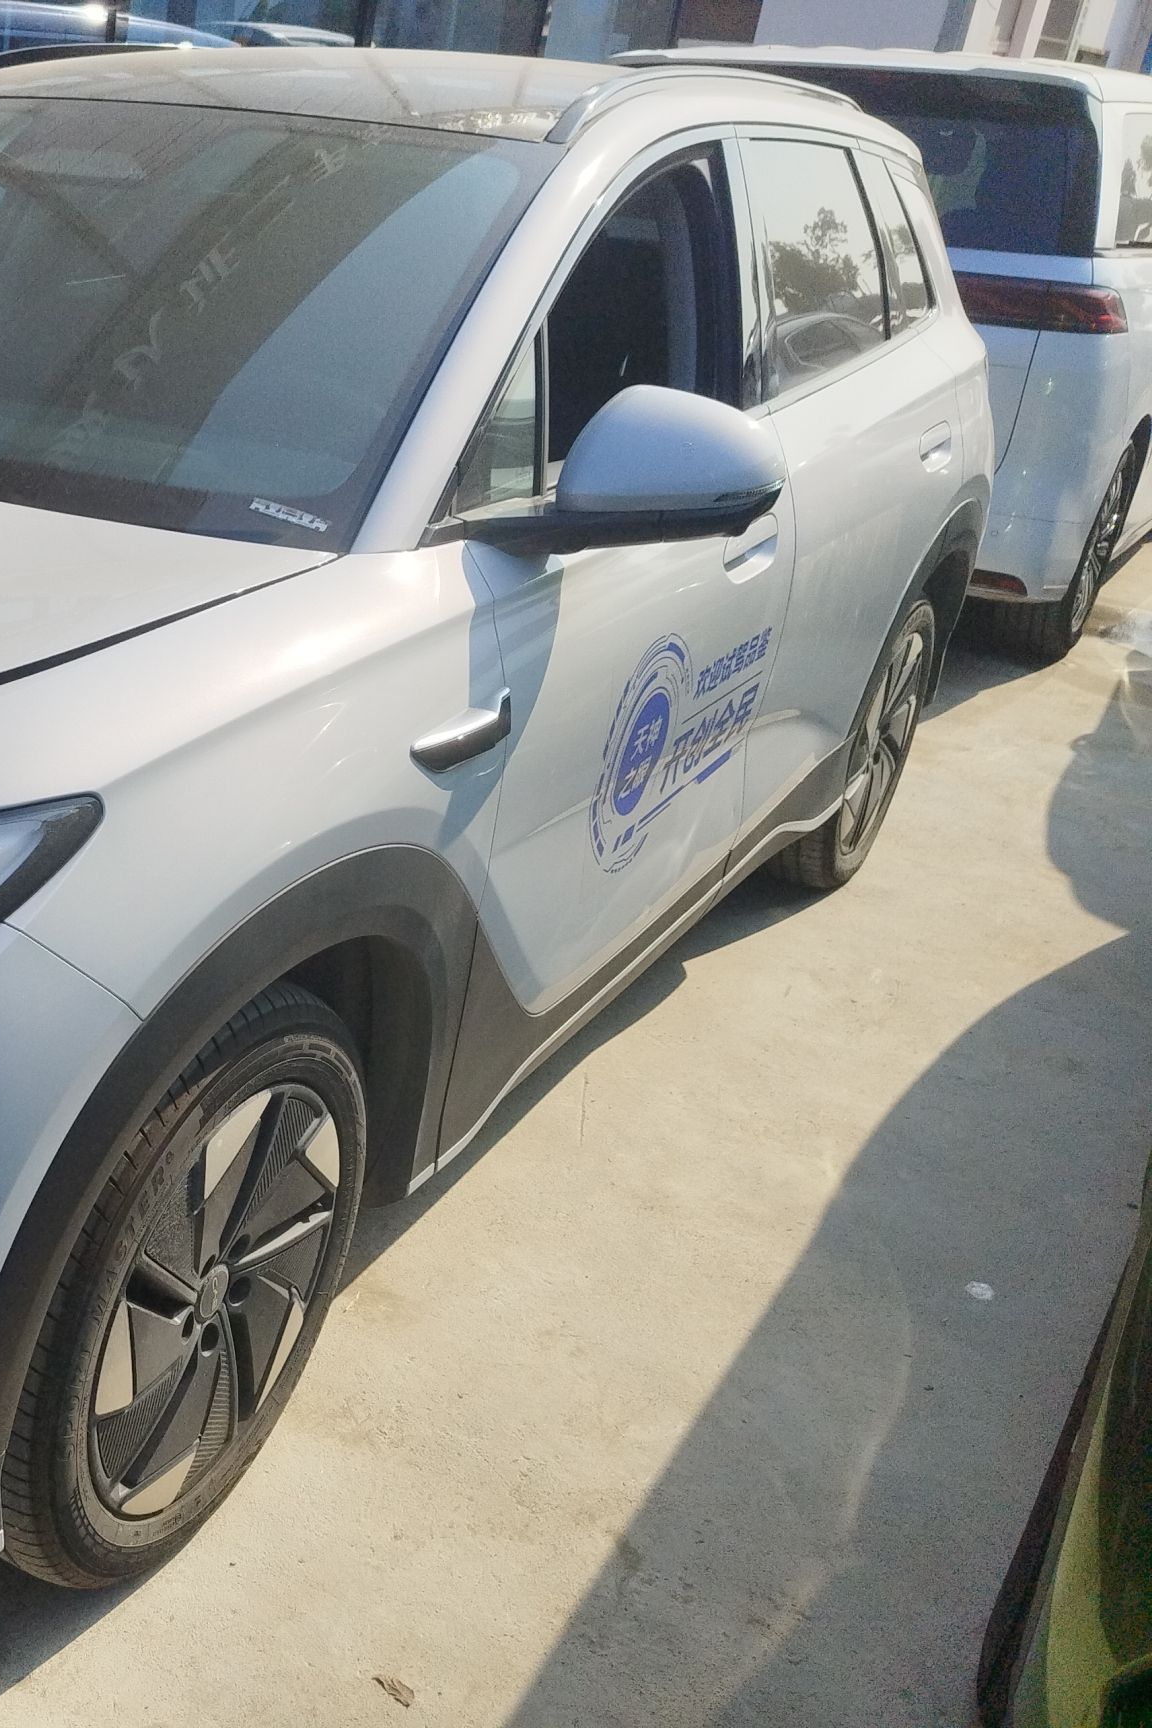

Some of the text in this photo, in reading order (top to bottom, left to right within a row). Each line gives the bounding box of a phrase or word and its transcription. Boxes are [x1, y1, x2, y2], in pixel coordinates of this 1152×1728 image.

[660, 682, 760, 794] 开创全民
[91, 1166, 166, 1325] MASTER
